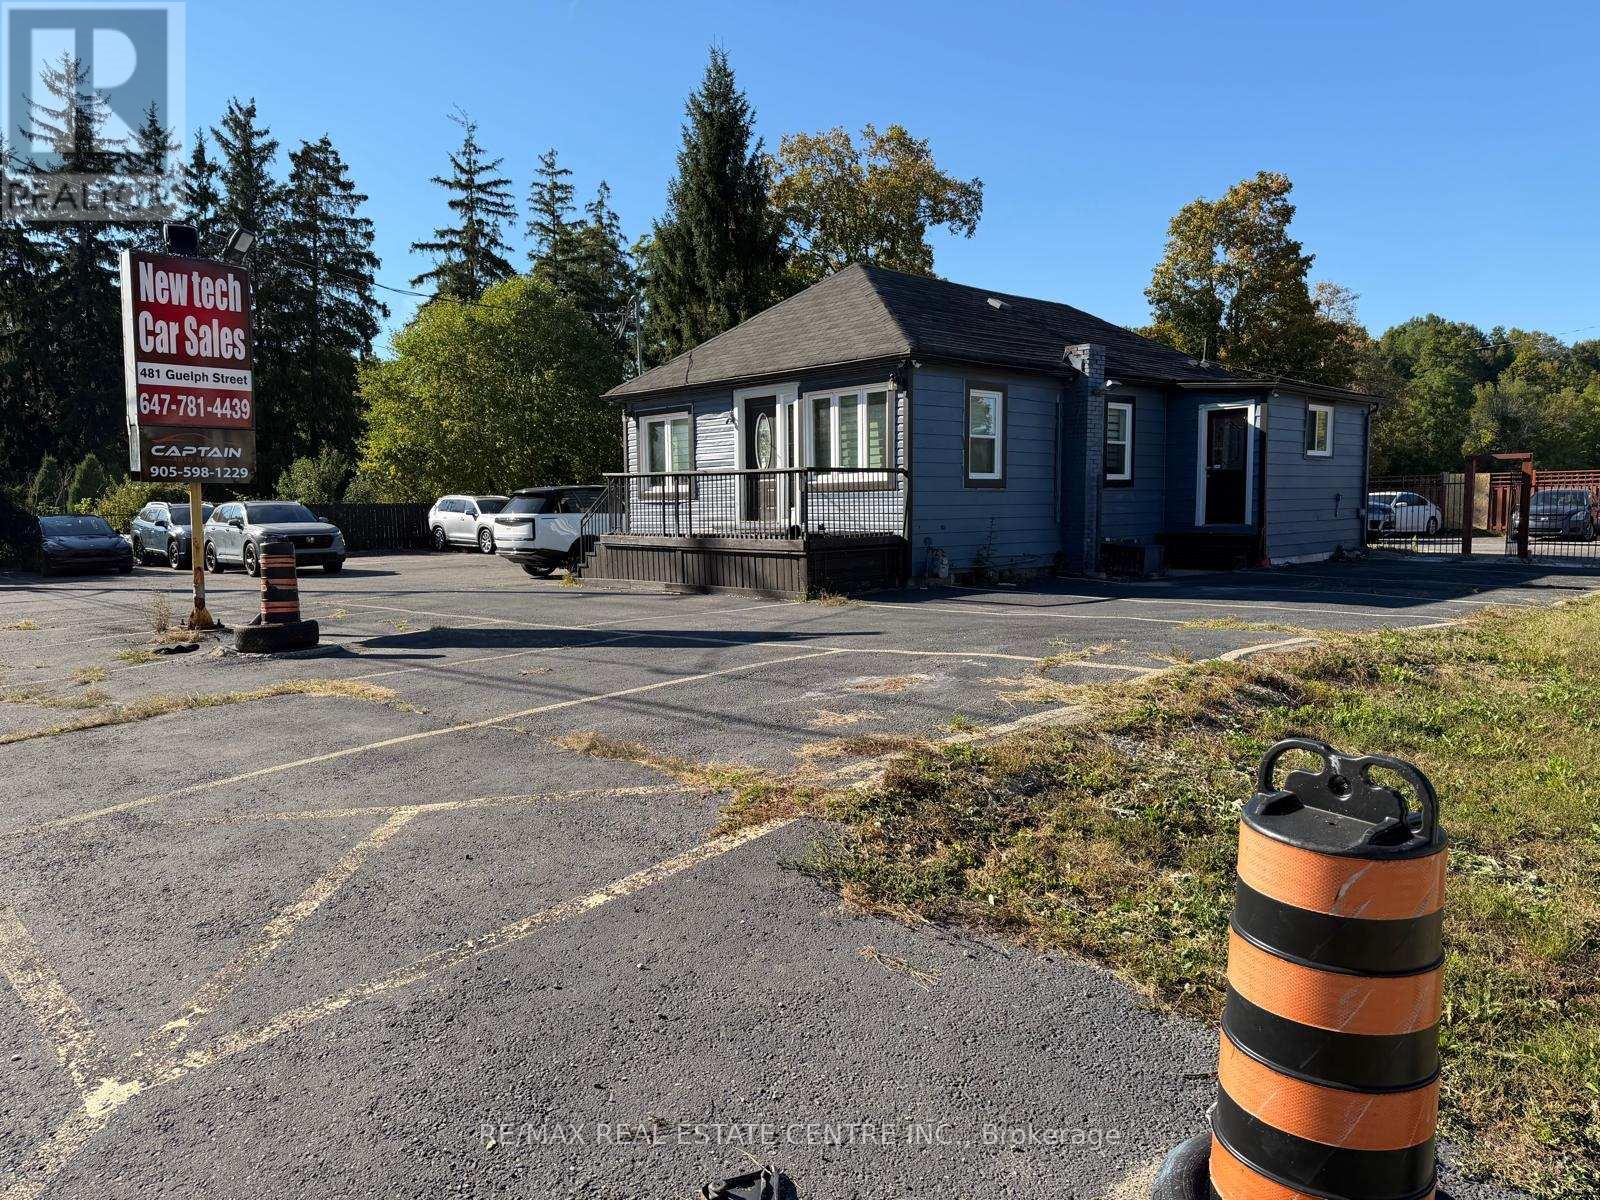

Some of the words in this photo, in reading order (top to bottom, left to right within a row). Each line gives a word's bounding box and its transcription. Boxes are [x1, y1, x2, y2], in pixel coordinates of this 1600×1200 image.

[138, 261, 188, 307] New
[191, 271, 242, 313] tech
[138, 310, 179, 355] Car
[184, 315, 246, 361] Sales
[139, 367, 161, 380] 481
[165, 369, 209, 384] Guelph
[212, 372, 248, 386] Street
[139, 392, 251, 420] 647-781-4439
[150, 445, 242, 458] CAPTAIN
[150, 465, 249, 478] 905-598-1229
